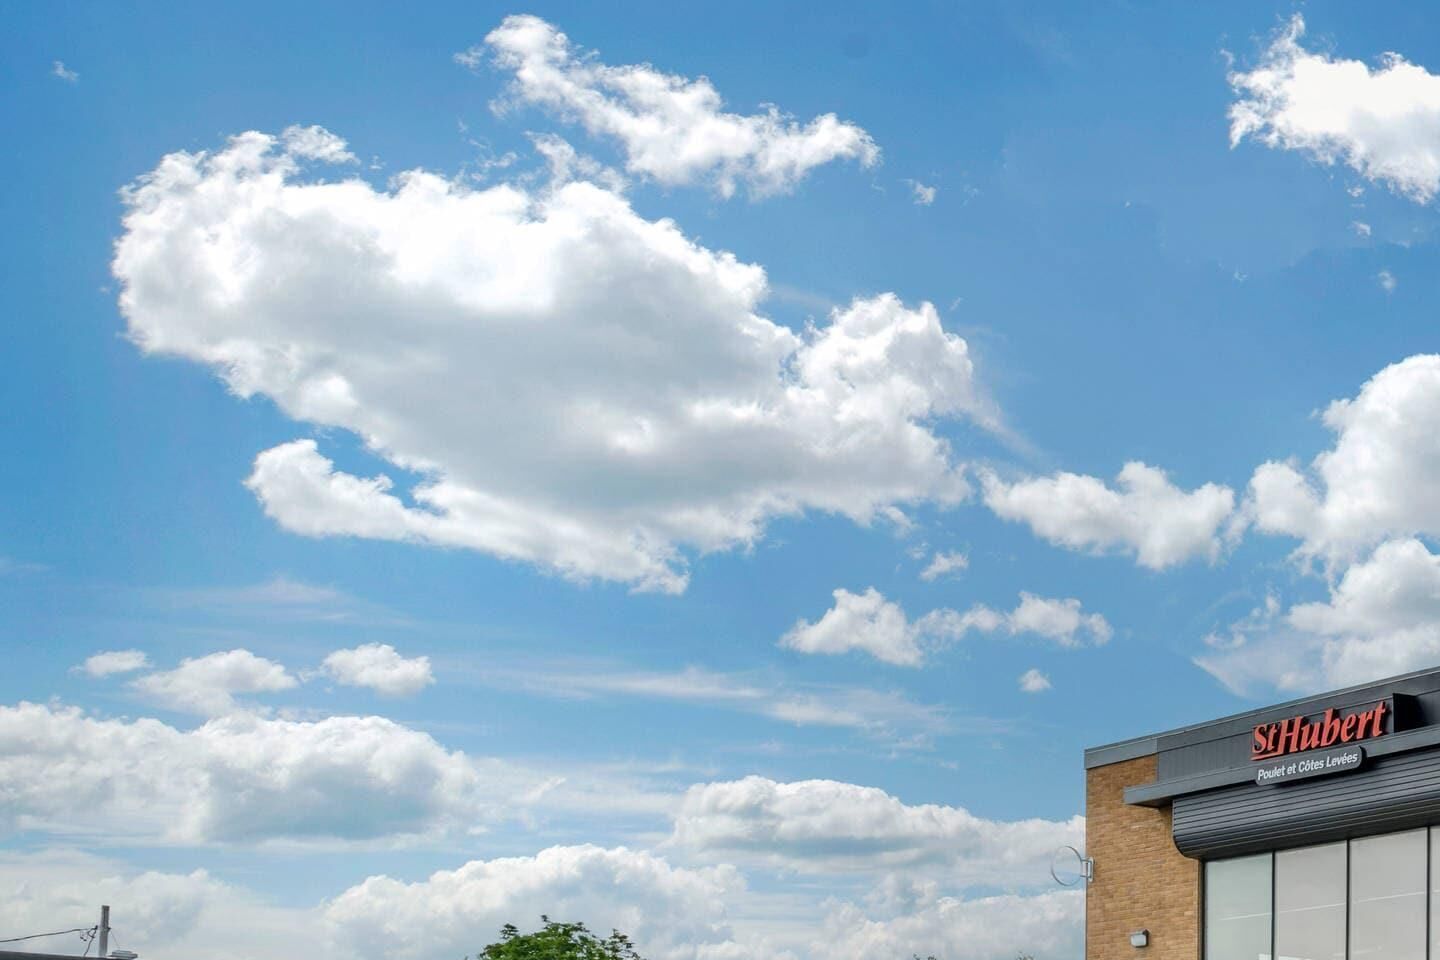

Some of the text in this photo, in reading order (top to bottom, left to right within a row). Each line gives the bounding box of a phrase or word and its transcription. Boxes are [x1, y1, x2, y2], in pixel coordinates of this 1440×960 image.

[1257, 752, 1358, 780] Poulet et Côtes Levées
